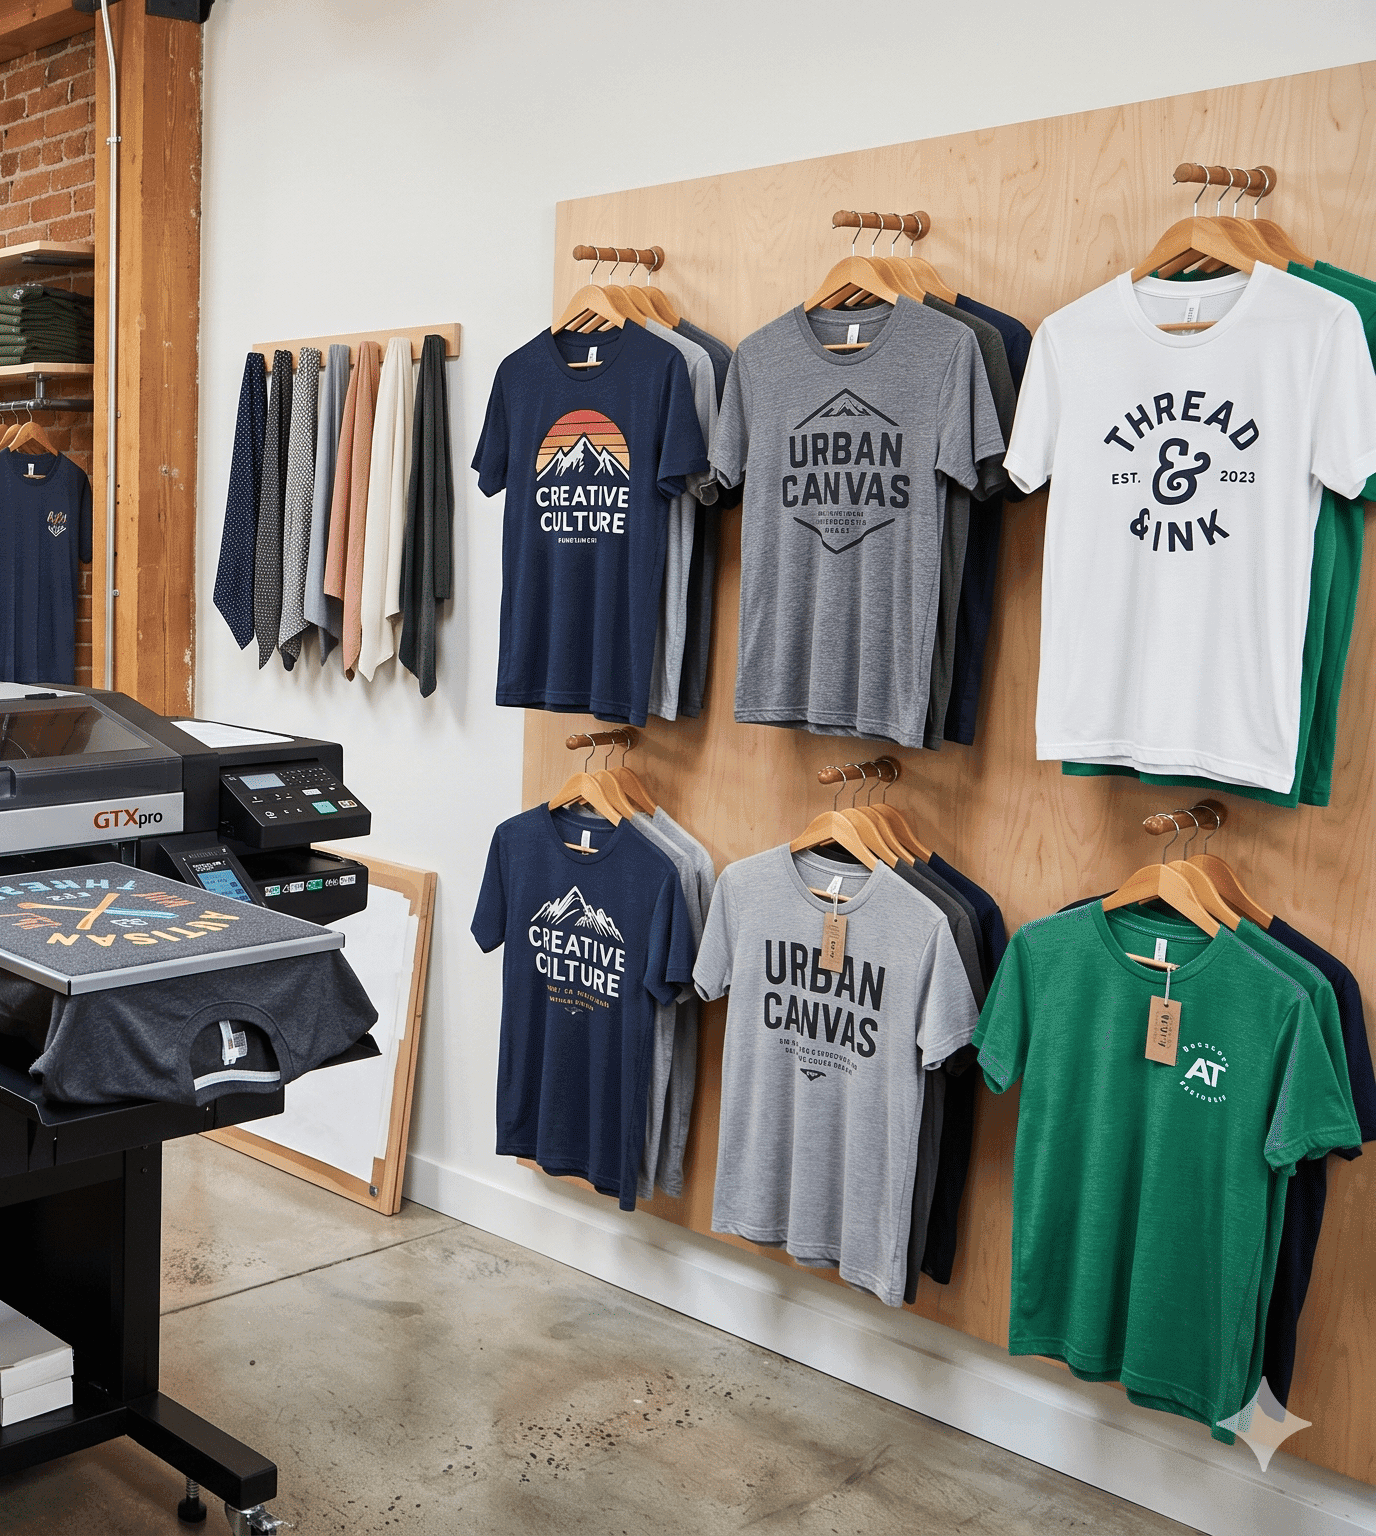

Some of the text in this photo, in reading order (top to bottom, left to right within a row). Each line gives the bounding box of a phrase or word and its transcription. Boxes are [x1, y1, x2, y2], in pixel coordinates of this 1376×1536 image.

[1103, 390, 1260, 452] THREAD
[788, 431, 904, 469] URBAN
[781, 471, 911, 509] CANVAS
[1111, 472, 1141, 485] EST.
[1151, 437, 1212, 506] &
[1219, 470, 1255, 484] 2023
[535, 485, 630, 508] CREATIVE
[540, 511, 626, 534] CULTURE
[93, 807, 164, 830] GTXpro
[528, 925, 626, 973] CREATIVE
[765, 939, 886, 1012] URBAN
[763, 991, 879, 1058] CANVAS
[1184, 1057, 1227, 1088] AT
